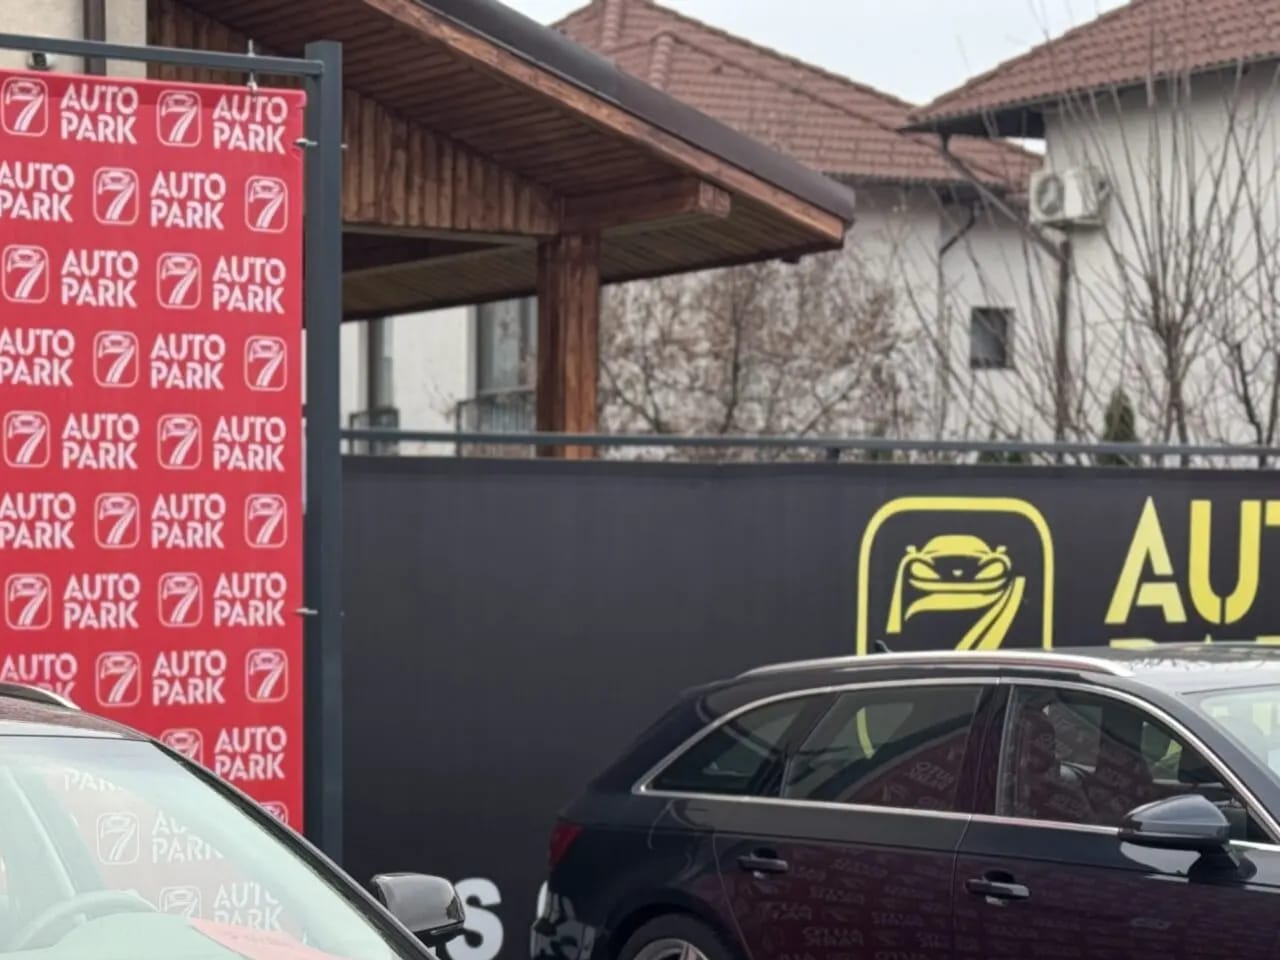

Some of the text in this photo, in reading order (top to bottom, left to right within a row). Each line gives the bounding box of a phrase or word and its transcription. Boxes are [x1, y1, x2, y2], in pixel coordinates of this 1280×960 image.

[60, 84, 138, 115] AUTO
[213, 95, 287, 124] AUTO
[61, 111, 137, 144] PARK
[214, 121, 285, 154] PARK
[151, 171, 226, 201] AUTO
[151, 199, 224, 229] PARK
[61, 250, 138, 279] AUTO
[213, 256, 286, 285] AUTO
[62, 277, 136, 307] PARK
[213, 283, 284, 313] PARK
[150, 334, 225, 361] AUTO
[151, 361, 223, 389] PARK
[62, 413, 139, 441] AUTO
[213, 416, 286, 443] AUTO
[63, 441, 137, 469] PARK
[214, 443, 284, 471] PARK
[152, 493, 226, 520] AUTO
[152, 521, 224, 548] PARK
[64, 573, 140, 601] AUTO
[214, 572, 287, 599] AUTO
[64, 601, 138, 629] PARK
[214, 599, 284, 626] PARK
[0, 653, 78, 681] AUTO
[152, 650, 226, 677] AUTO
[153, 677, 225, 705] PARK
[215, 726, 287, 754] AUTO
[216, 753, 285, 780] PARK
